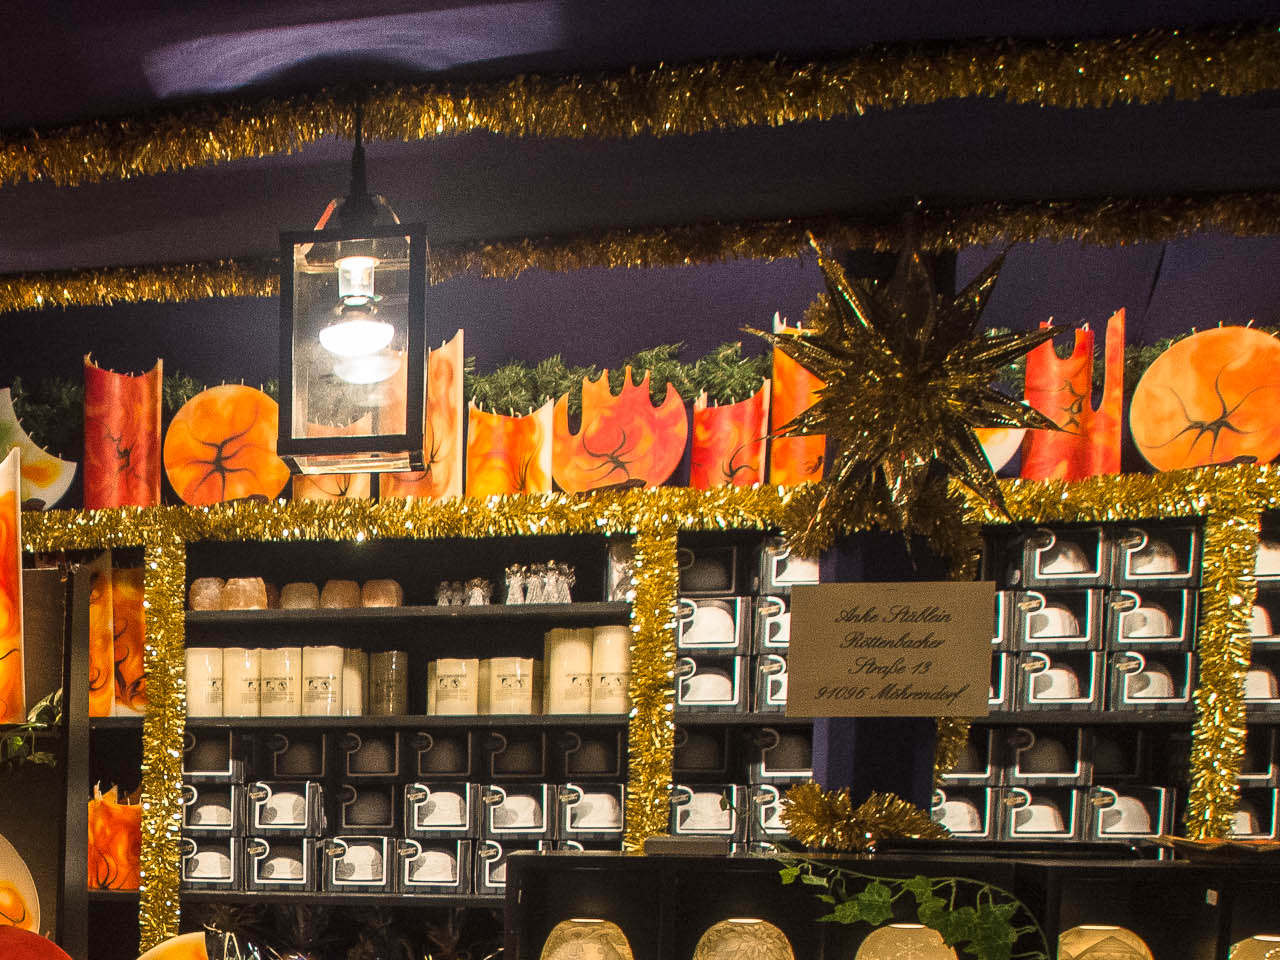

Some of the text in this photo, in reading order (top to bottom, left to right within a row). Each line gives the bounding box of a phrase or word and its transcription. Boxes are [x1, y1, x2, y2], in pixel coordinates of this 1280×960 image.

[834, 605, 880, 624] Anke
[847, 656, 933, 680] Straße 13
[814, 686, 870, 701] 91096
